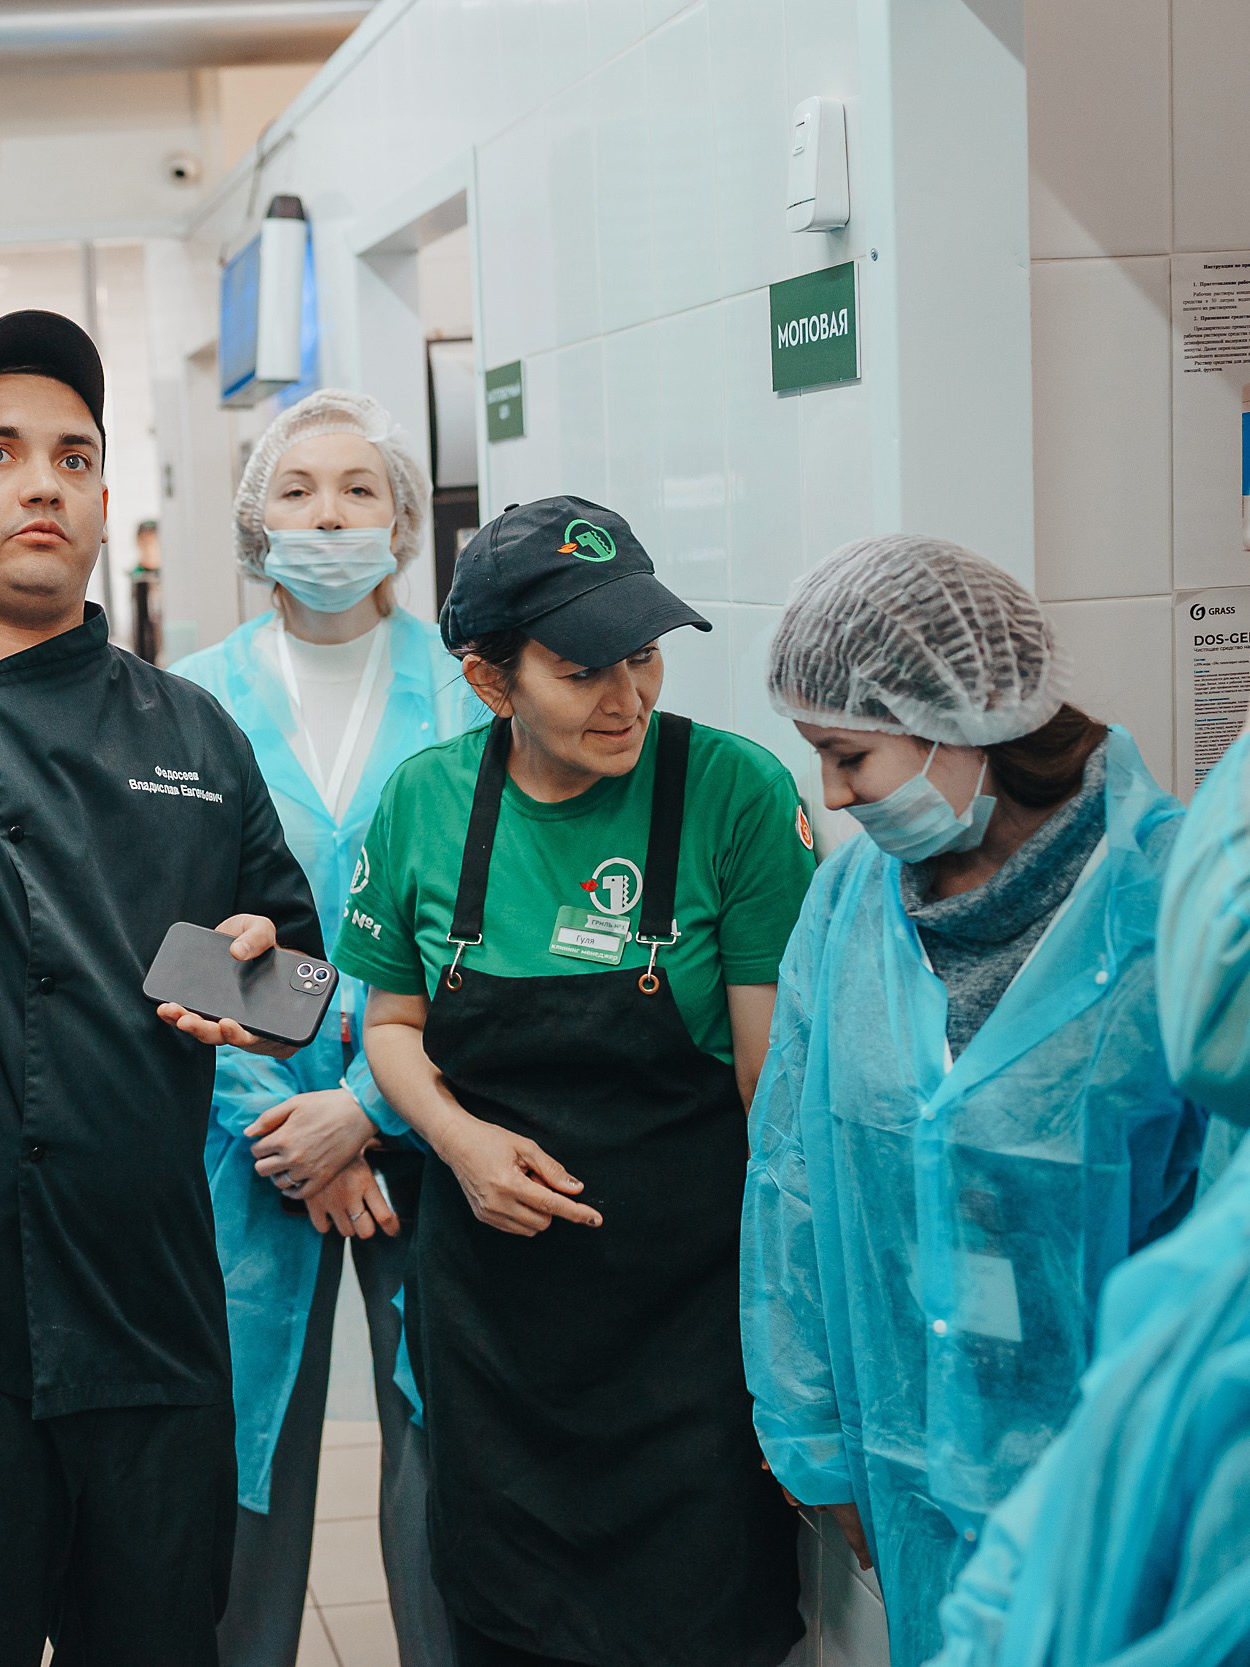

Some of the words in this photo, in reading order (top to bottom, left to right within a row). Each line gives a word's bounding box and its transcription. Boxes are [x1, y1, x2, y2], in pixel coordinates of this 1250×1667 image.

[777, 308, 848, 349] МОПОВАЯ
[1208, 606, 1236, 615] GRASS
[1194, 632, 1250, 646] DOS-GE
[154, 765, 200, 780] Федосеев
[128, 779, 180, 795] Владислав
[180, 784, 223, 803] Евгеньевич
[592, 919, 613, 928] ГРИЛЬ
[576, 935, 595, 944] Гуля
